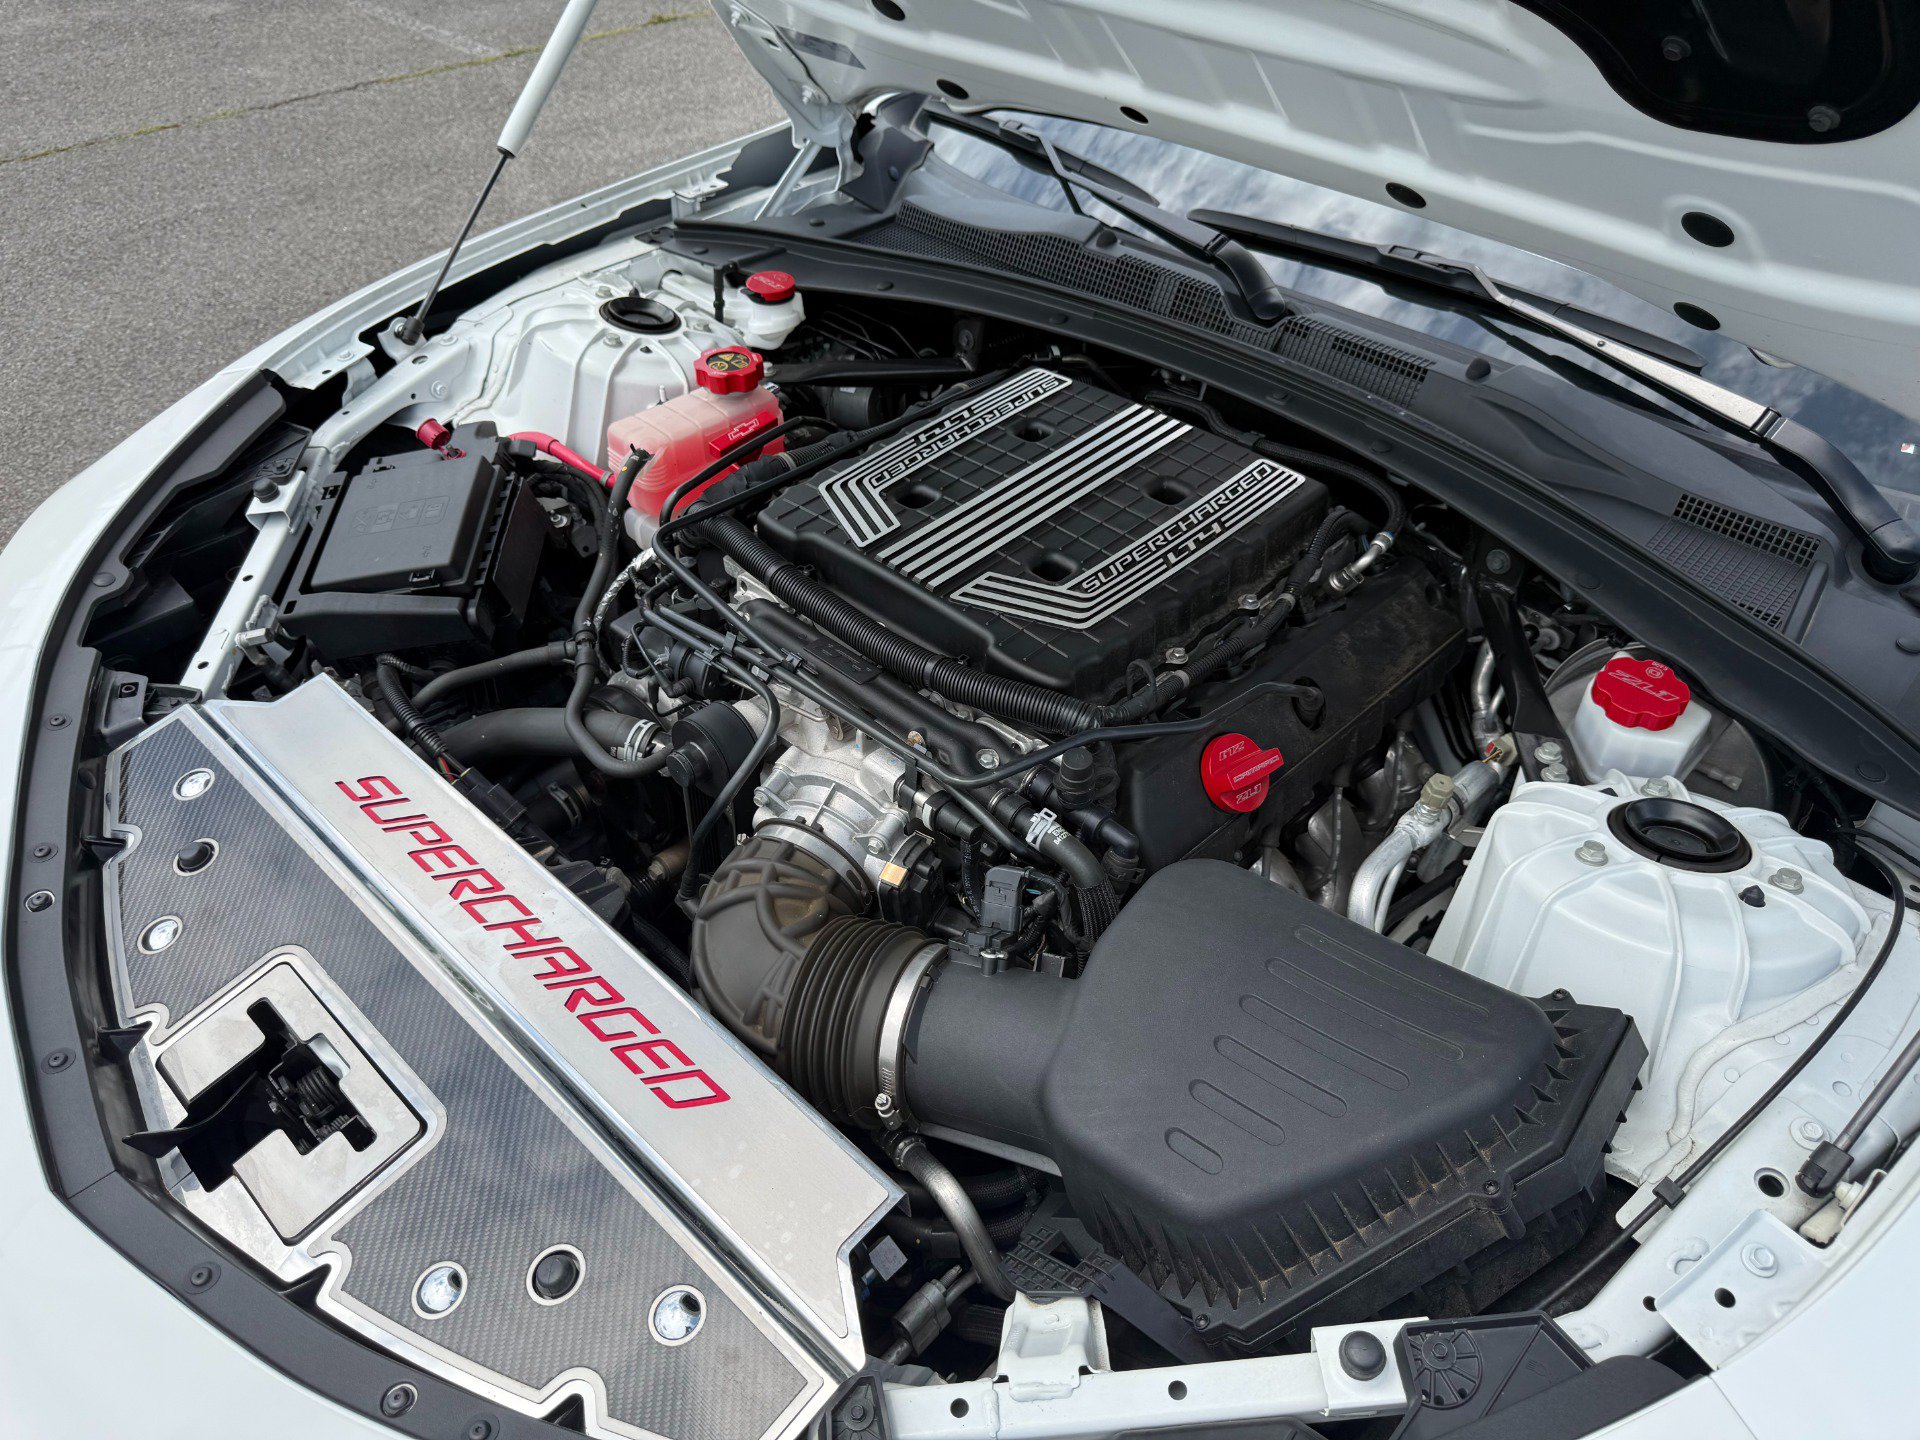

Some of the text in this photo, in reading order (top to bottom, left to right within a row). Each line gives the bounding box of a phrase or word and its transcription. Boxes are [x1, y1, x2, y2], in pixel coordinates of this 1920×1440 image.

[871, 378, 1060, 488] SUPERCHARGED
[918, 409, 971, 444] LT4
[1081, 462, 1273, 592] SUPERCHARGED
[1167, 521, 1223, 564] LT4
[334, 775, 732, 1109] SUPERCHARGED
